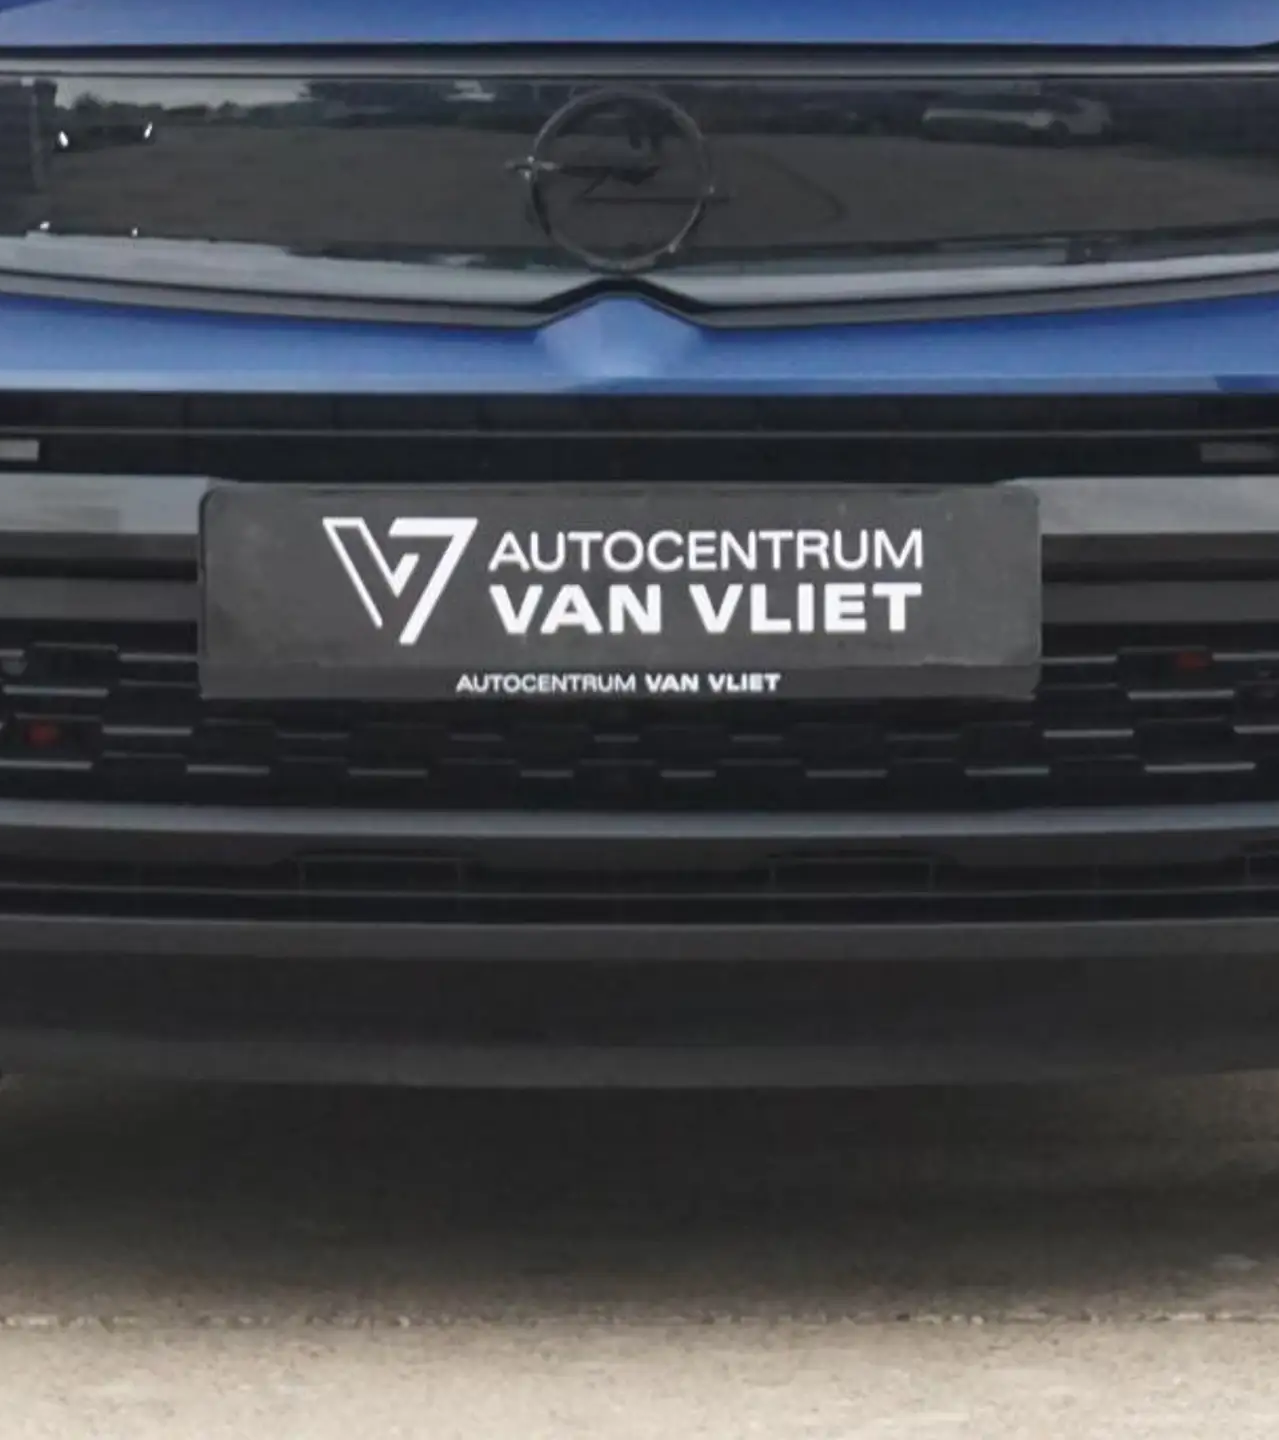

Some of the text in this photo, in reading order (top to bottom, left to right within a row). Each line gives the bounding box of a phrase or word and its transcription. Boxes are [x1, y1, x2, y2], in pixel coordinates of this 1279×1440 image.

[487, 528, 924, 573] AUTOCENTRUM
[488, 581, 923, 635] VAN VLIET
[455, 672, 782, 693] AUTOCENTRUM VAN VLIET
